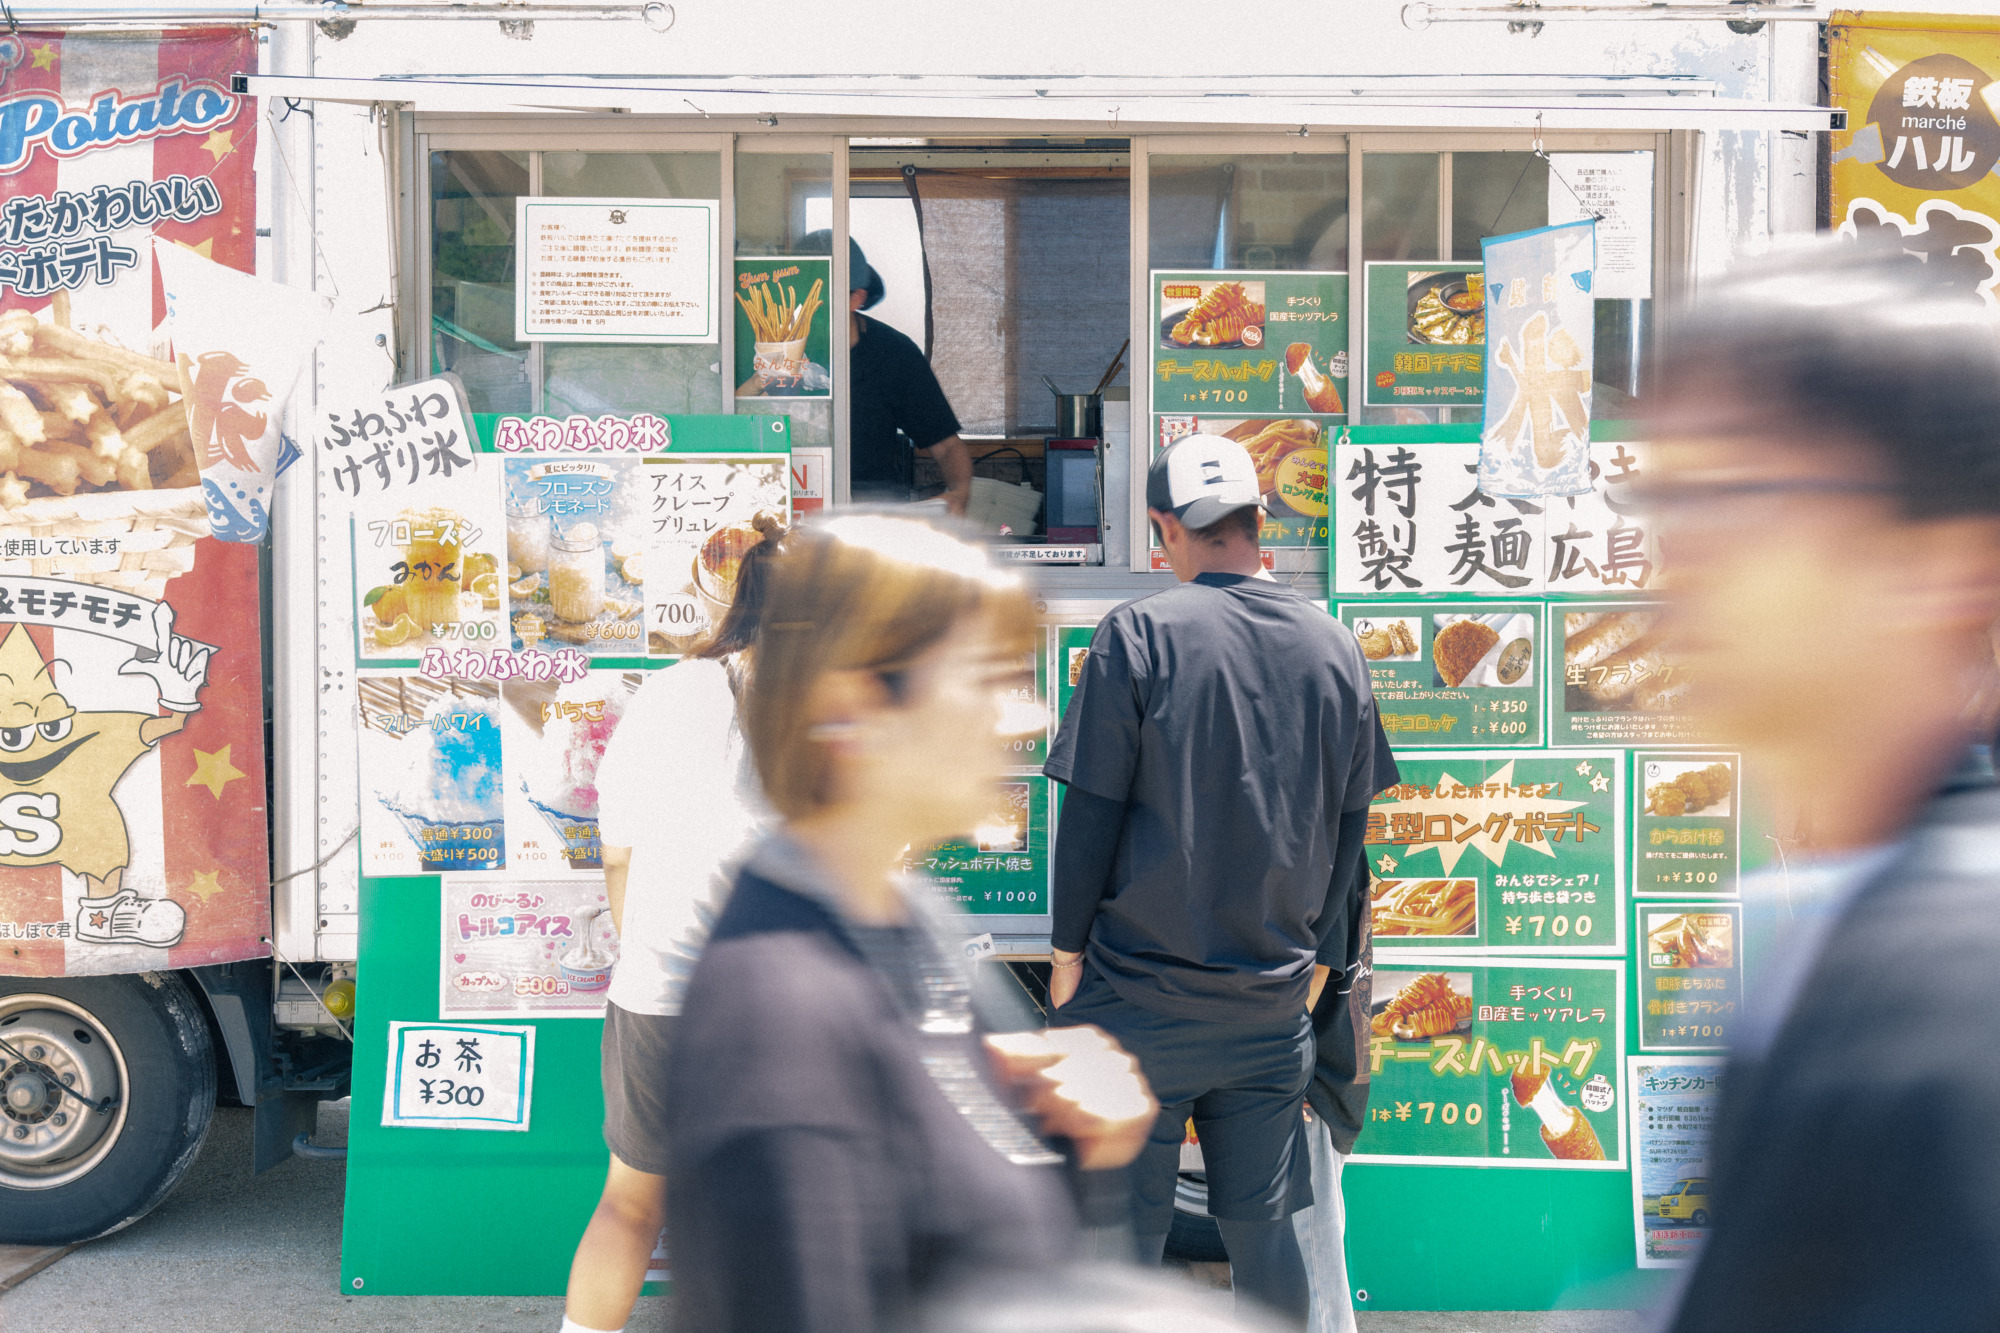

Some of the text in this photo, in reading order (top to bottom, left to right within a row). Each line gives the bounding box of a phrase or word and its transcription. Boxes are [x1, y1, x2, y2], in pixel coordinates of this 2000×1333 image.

[1902, 76, 1975, 110] 鉄板
[0, 82, 230, 165] Potato
[1902, 114, 1967, 130] marché
[1887, 136, 1976, 172] ハル
[0, 178, 216, 241] たかわいい
[738, 265, 800, 289] Yum yum
[1287, 296, 1322, 306] 手づくり
[1269, 311, 1339, 322] 国産モッツアレラ
[754, 356, 810, 371] みんなで
[1158, 360, 1276, 382] チーズハットグ
[1394, 353, 1481, 373] 韓国チヂミ
[760, 374, 804, 388] シェア
[324, 392, 450, 452] ふわふわ
[496, 415, 669, 451] ふわふわ氷
[333, 429, 471, 498] けずり氷
[1291, 455, 1328, 472] みんなで
[537, 479, 612, 497] フローズン
[651, 473, 705, 491] アイス
[537, 498, 611, 515] レモネード
[651, 492, 735, 513] クレープ
[652, 517, 718, 535] ブリュレ
[1345, 446, 1424, 590] 特製
[368, 519, 484, 548] フローズン
[0, 537, 121, 556] 使用しています
[389, 561, 462, 585] みかん
[431, 621, 496, 641] ¥700
[586, 621, 640, 640] ¥600
[420, 647, 588, 683] ふわふわ氷
[541, 699, 606, 722] いちご
[377, 712, 486, 733] ブルーハワイ
[1649, 829, 1725, 846] からあげ棒
[1494, 873, 1600, 888] みんなでシェア!
[1501, 890, 1597, 905] 持ち歩き袋つき
[0, 922, 72, 940] ほしぽて君
[458, 913, 574, 940] トルコアイス
[1505, 915, 1593, 937] ¥700
[1652, 955, 1672, 965] 国産
[514, 976, 569, 996] 500円
[1509, 985, 1573, 1002] 手づくり
[1478, 1006, 1606, 1024] 国産モッツアレラ
[1370, 1037, 1598, 1077] チーズハットグ
[419, 1078, 485, 1107] ¥300
